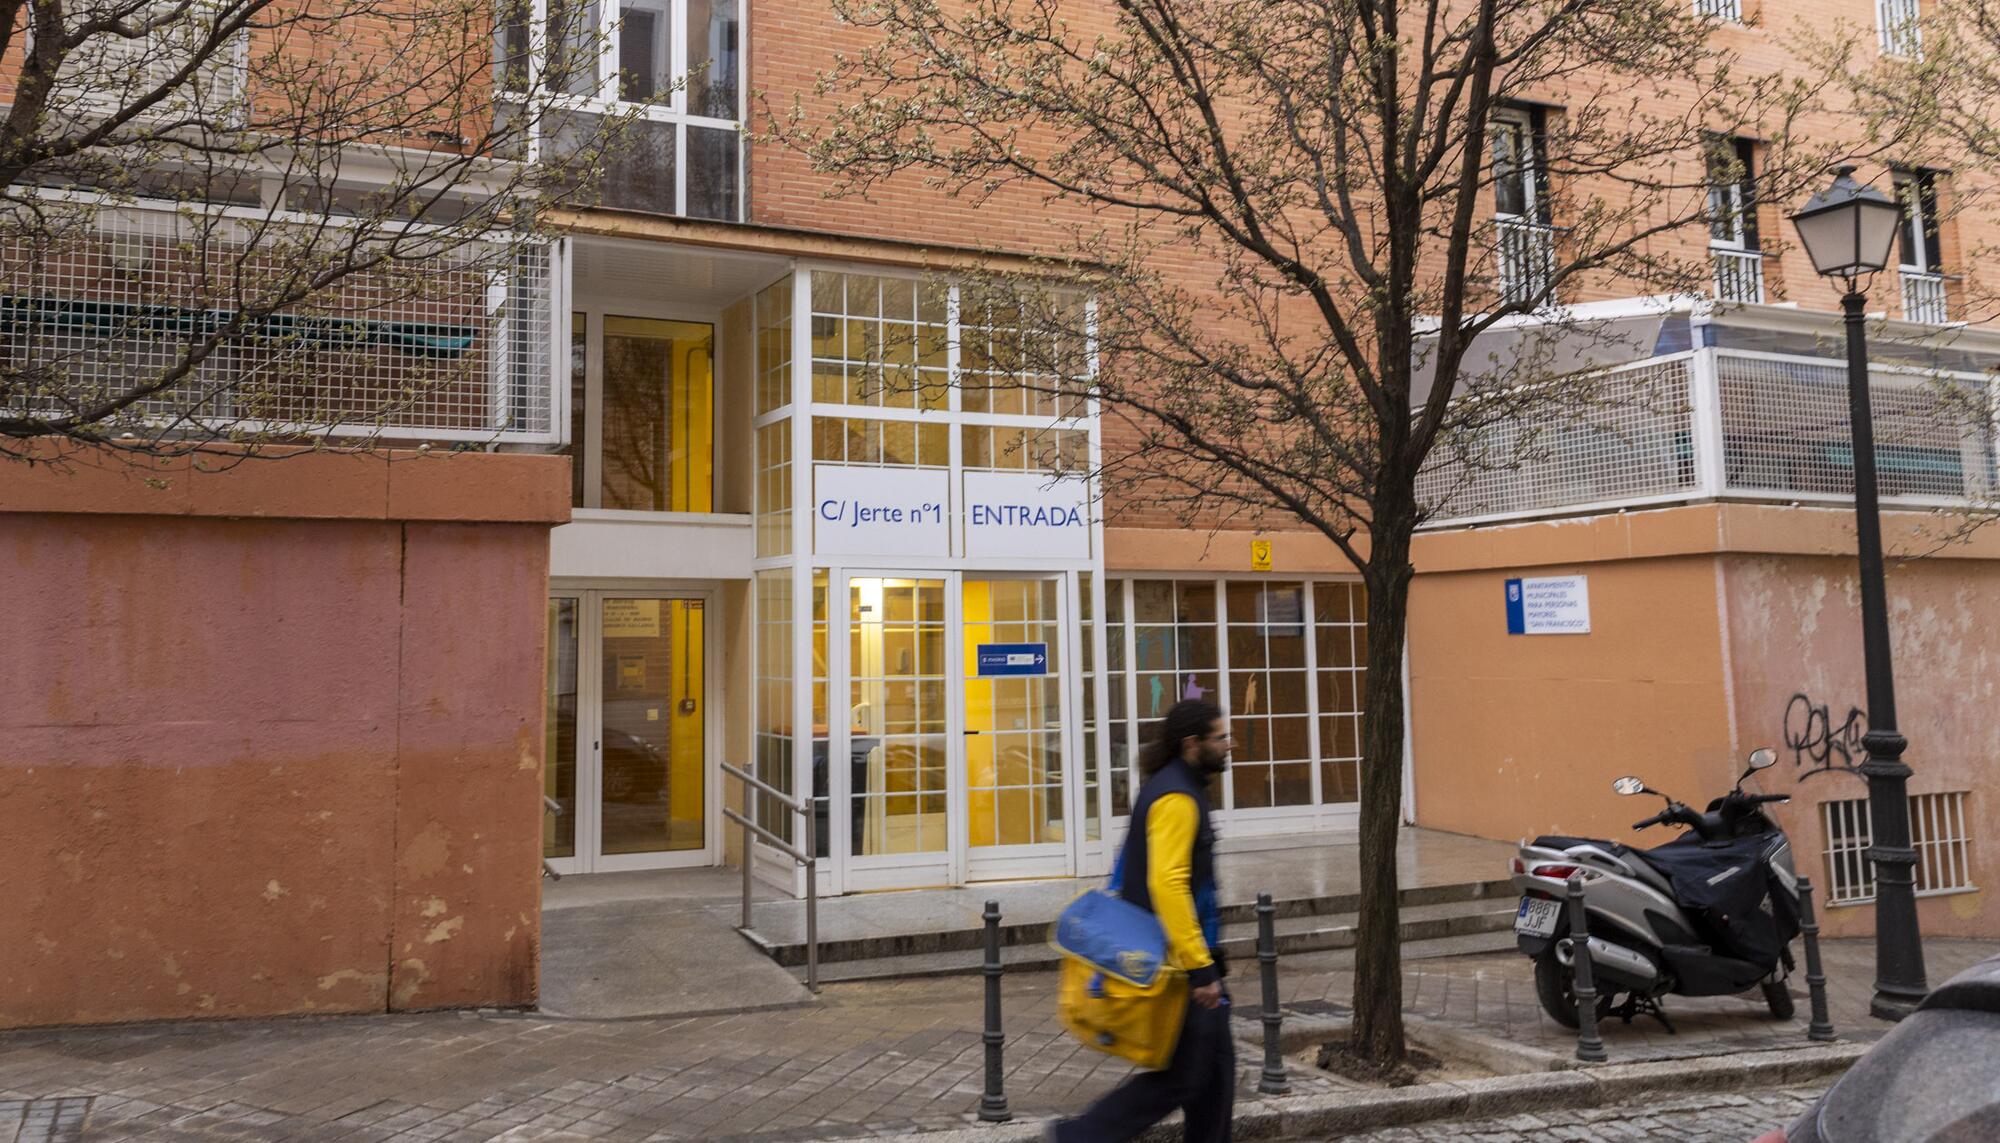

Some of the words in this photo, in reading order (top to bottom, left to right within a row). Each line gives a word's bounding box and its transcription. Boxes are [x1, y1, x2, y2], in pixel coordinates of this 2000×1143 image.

[821, 500, 846, 521] C/
[851, 500, 903, 528] Jerte
[972, 504, 1082, 527] ENTRADA
[1524, 915, 1547, 929] JJF
